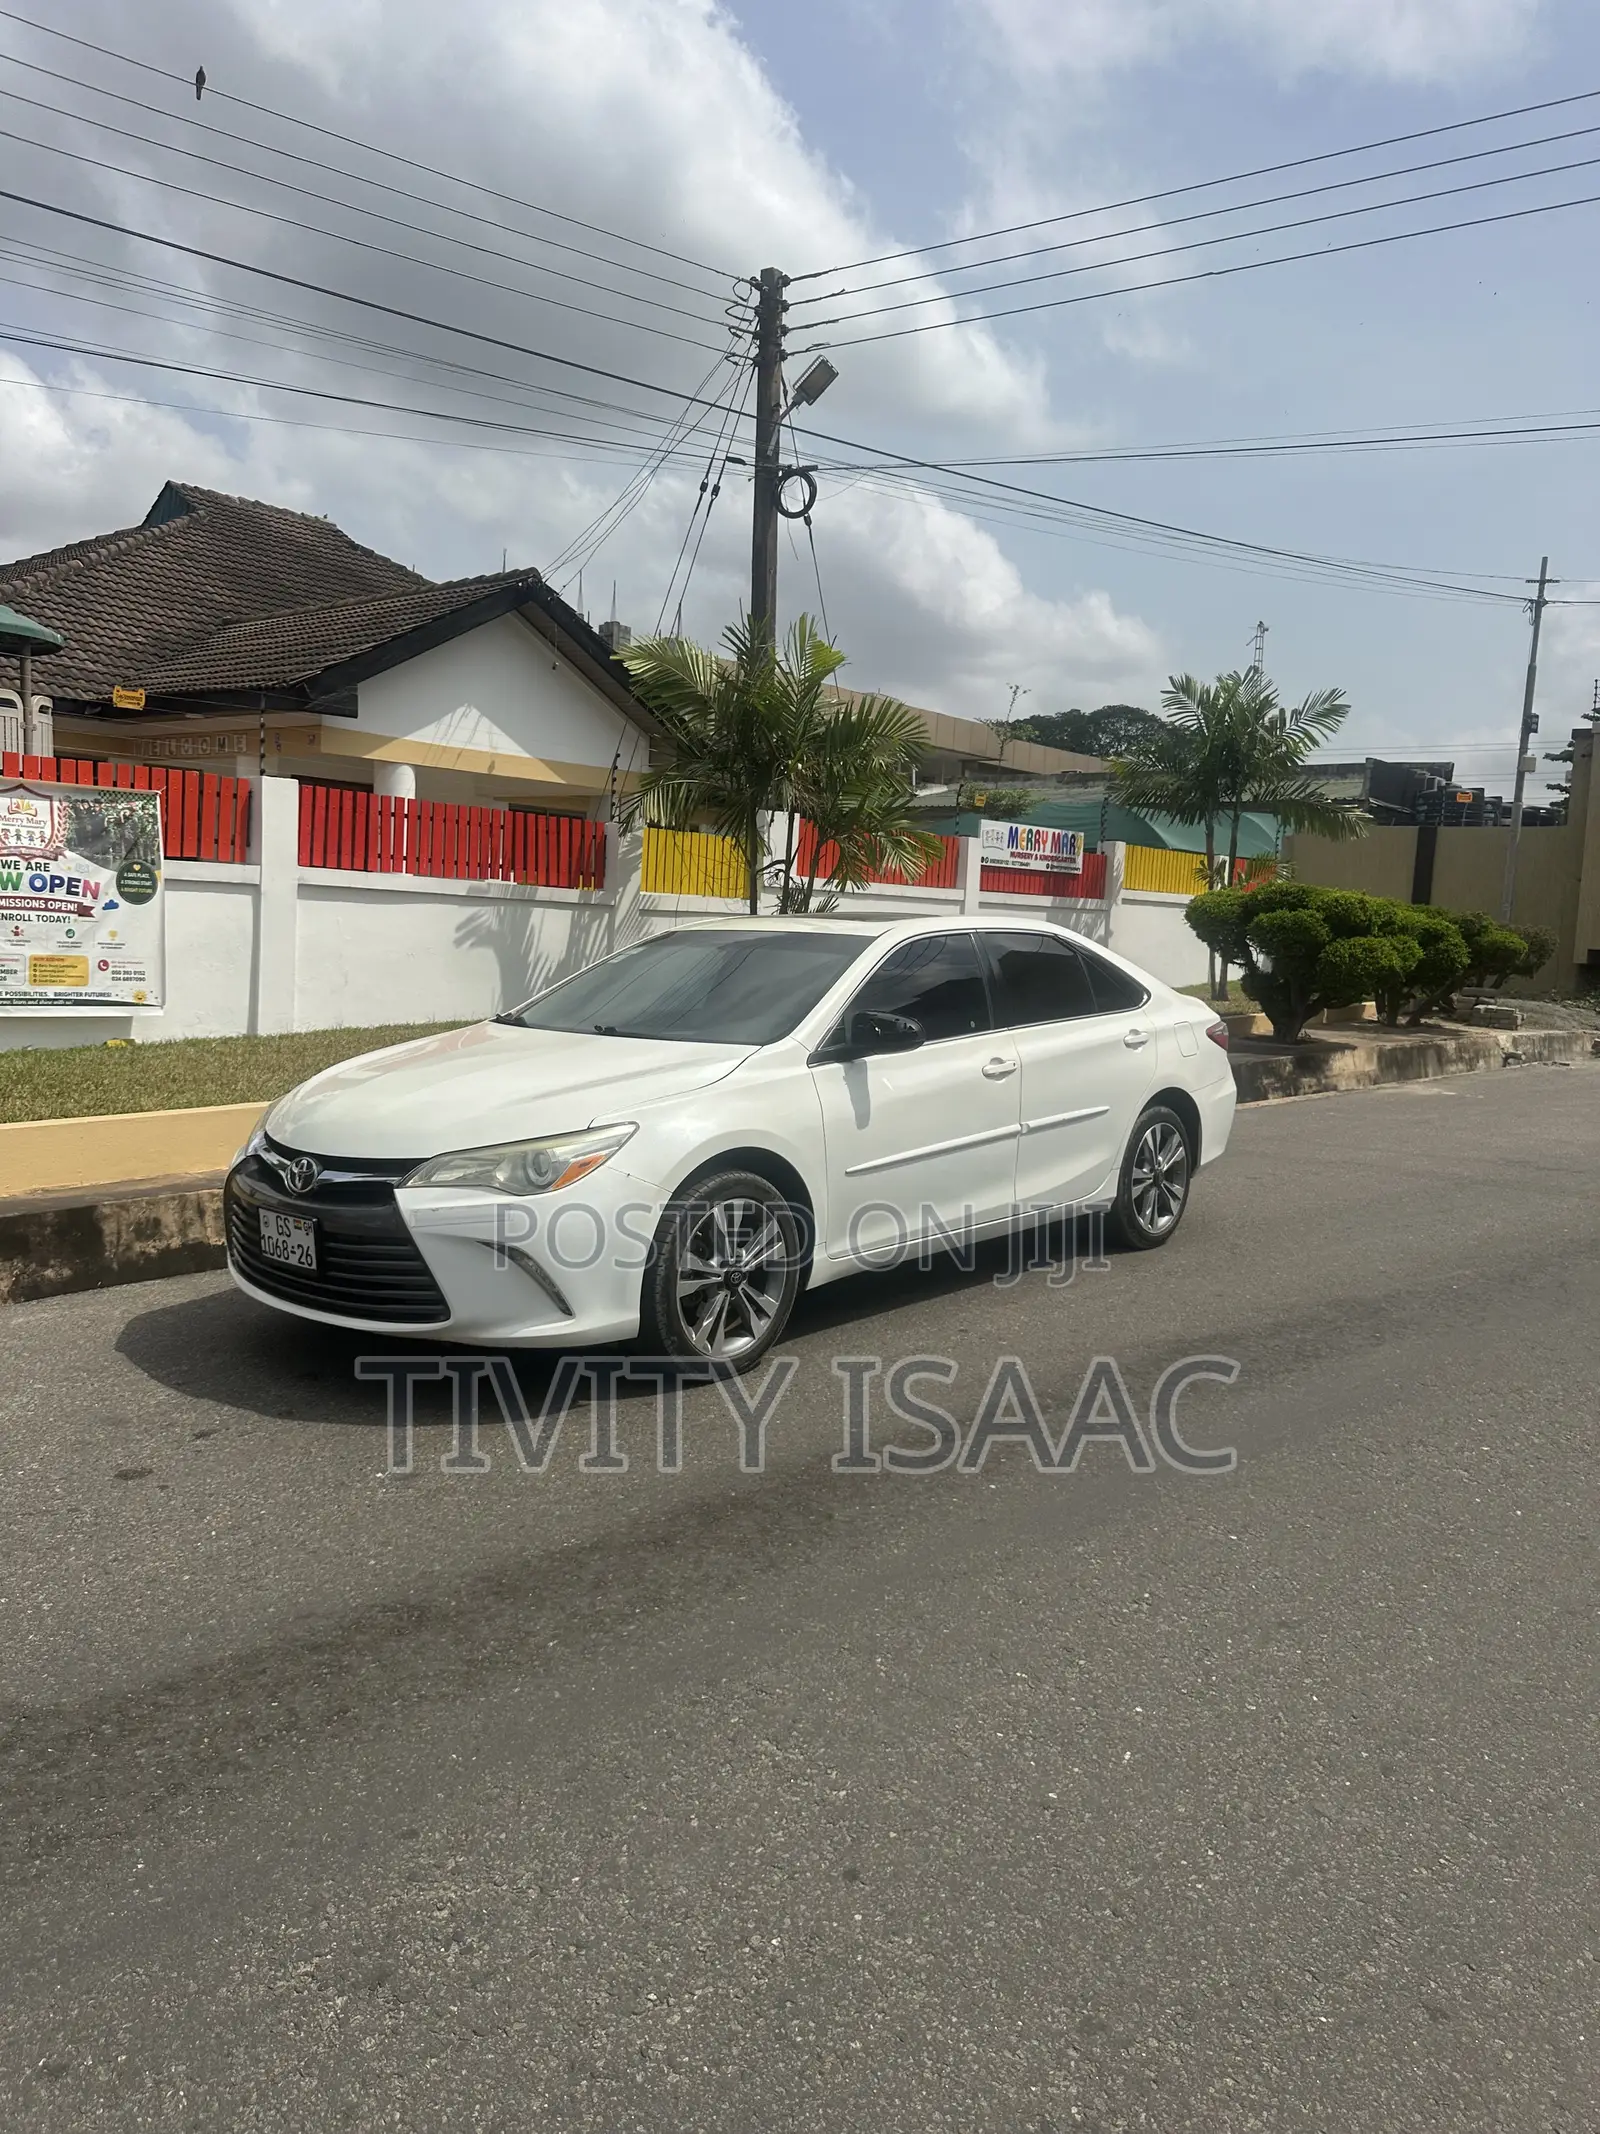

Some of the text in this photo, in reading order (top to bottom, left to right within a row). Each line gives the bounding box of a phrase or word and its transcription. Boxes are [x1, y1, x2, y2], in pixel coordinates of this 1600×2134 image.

[142, 735, 246, 756] ELCOME
[26, 817, 47, 826] Mary
[1007, 826, 1083, 856] MERRY MARY
[1, 860, 50, 872] WE ARE
[1010, 852, 1033, 861] NURSERY
[1039, 854, 1076, 864] KINDERGARTEN
[29, 873, 101, 900] OPEN
[48, 900, 78, 911] OPEN!
[36, 914, 71, 923] TODAY!
[275, 1215, 312, 1238] GS GH
[261, 1234, 313, 1266] 1068-26
